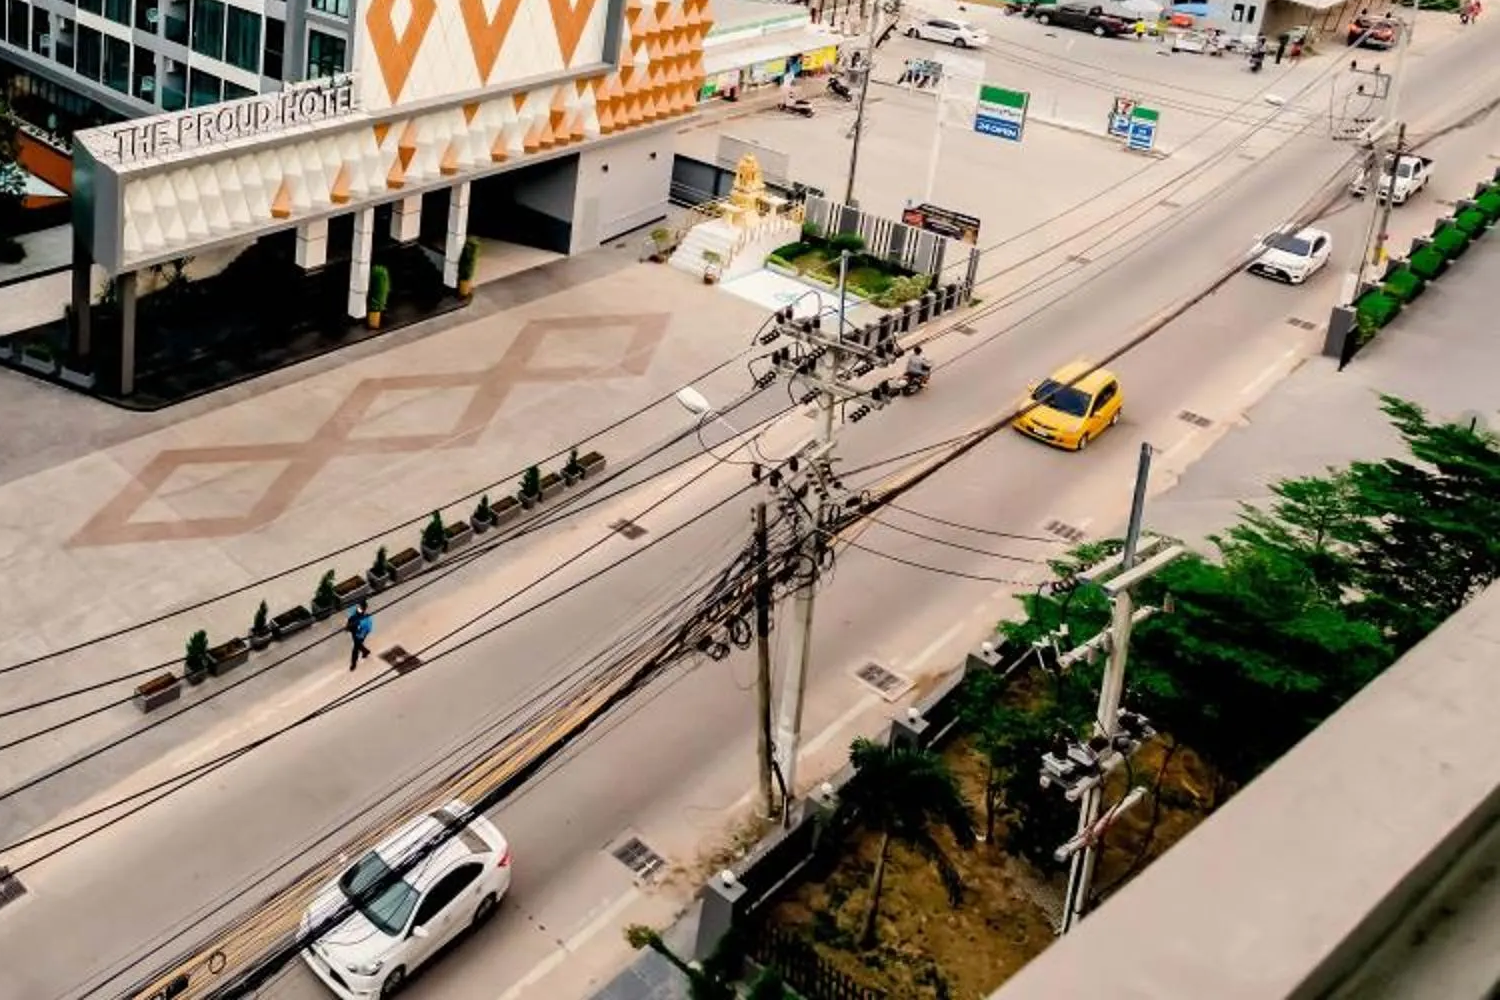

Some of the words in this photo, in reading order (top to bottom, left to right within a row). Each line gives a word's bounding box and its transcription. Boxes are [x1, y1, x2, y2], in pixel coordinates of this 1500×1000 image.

[113, 119, 174, 163] THE
[177, 100, 275, 149] PROUD
[280, 83, 358, 124] HOTEL
